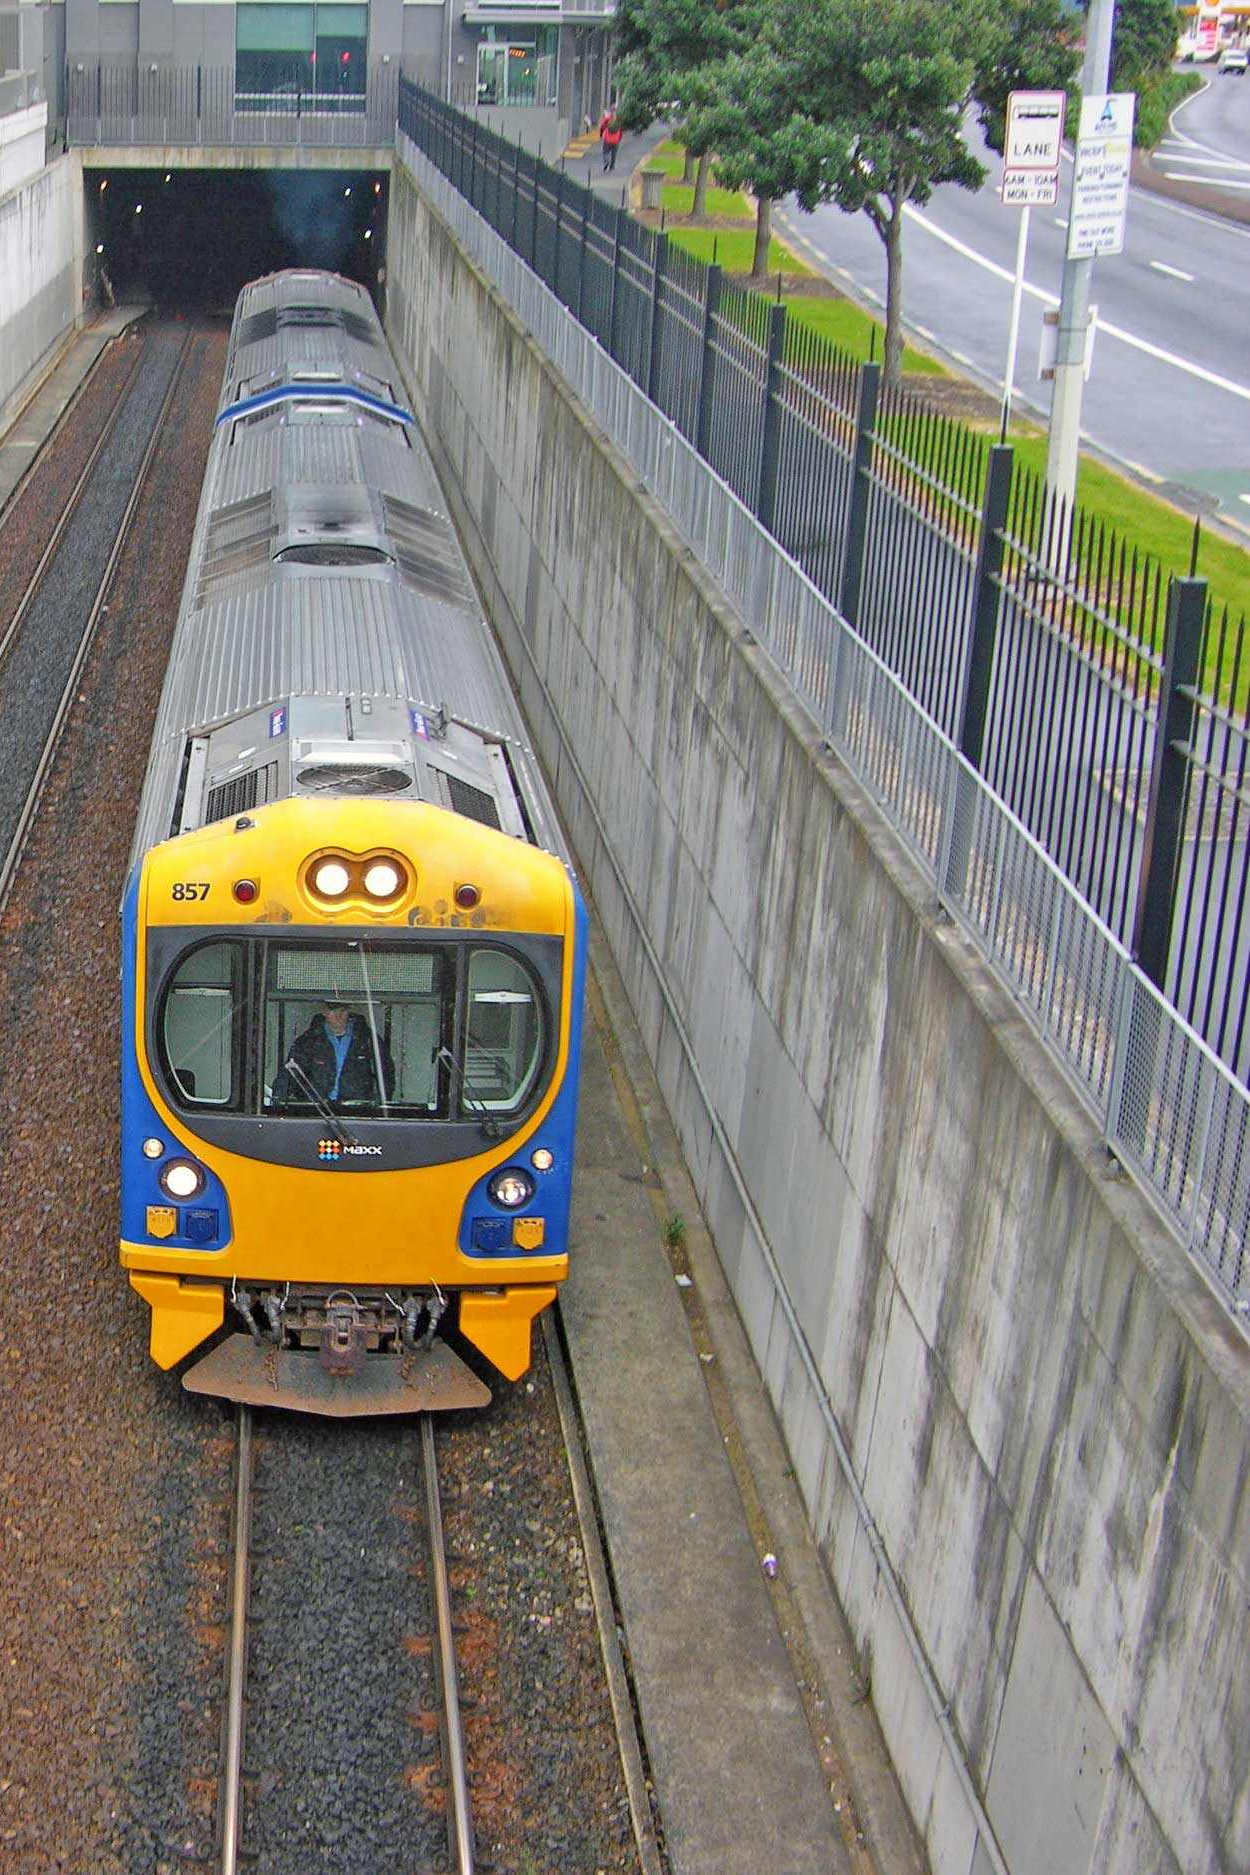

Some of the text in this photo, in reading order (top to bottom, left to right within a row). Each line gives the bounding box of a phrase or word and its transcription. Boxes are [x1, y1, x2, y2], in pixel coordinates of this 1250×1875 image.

[1014, 143, 1052, 156] LANE
[1035, 173, 1058, 184] 10AM
[1007, 189, 1028, 199] MON
[1038, 189, 1052, 199] FRI
[172, 883, 210, 901] 857
